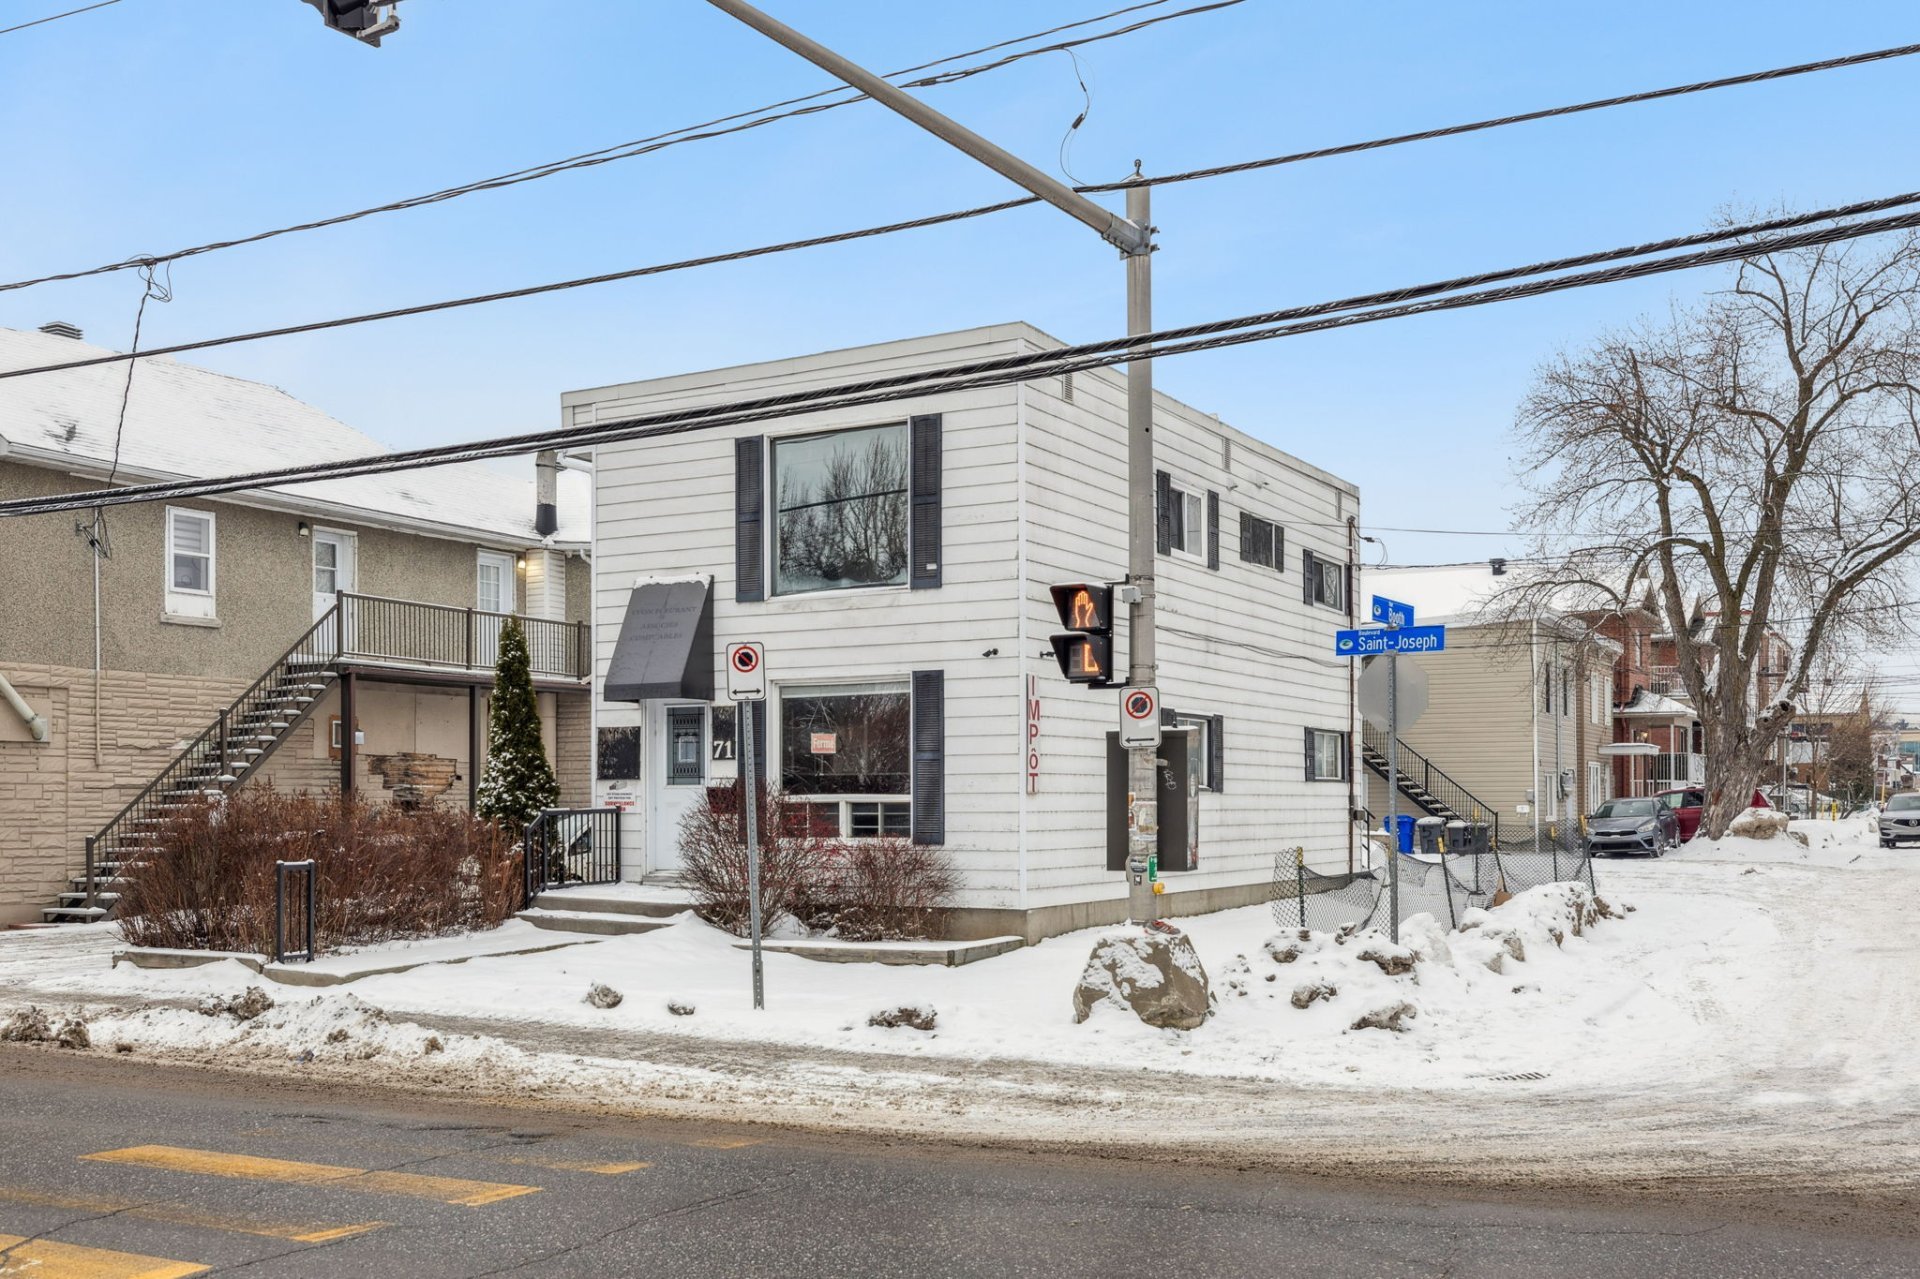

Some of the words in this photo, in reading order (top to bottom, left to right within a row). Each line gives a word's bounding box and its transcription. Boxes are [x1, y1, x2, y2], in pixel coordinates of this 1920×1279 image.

[1358, 634, 1437, 651] Saint-Joseph
[1028, 675, 1040, 793] IMPÔT
[713, 740, 733, 759] 71
